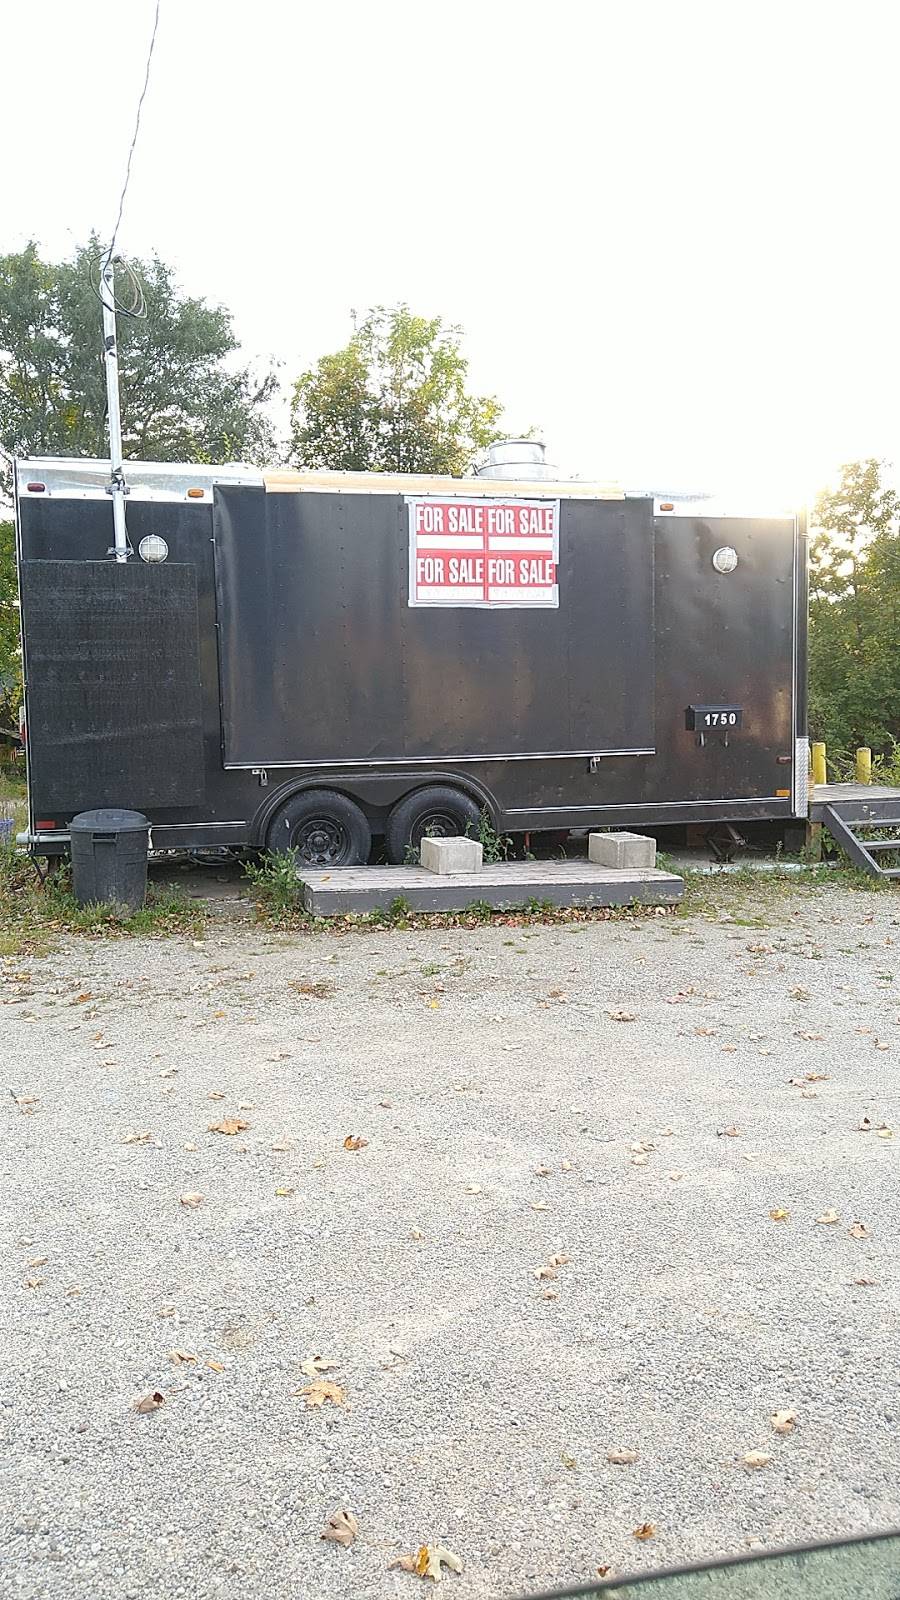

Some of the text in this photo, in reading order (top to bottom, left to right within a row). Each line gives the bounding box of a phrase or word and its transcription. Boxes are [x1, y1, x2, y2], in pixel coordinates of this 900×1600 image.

[416, 507, 484, 533] FOR SALE
[488, 509, 553, 534] FOR SALE
[416, 558, 484, 584] FOR SALE
[488, 559, 554, 584] FOR SALE
[704, 713, 737, 726] 1750
